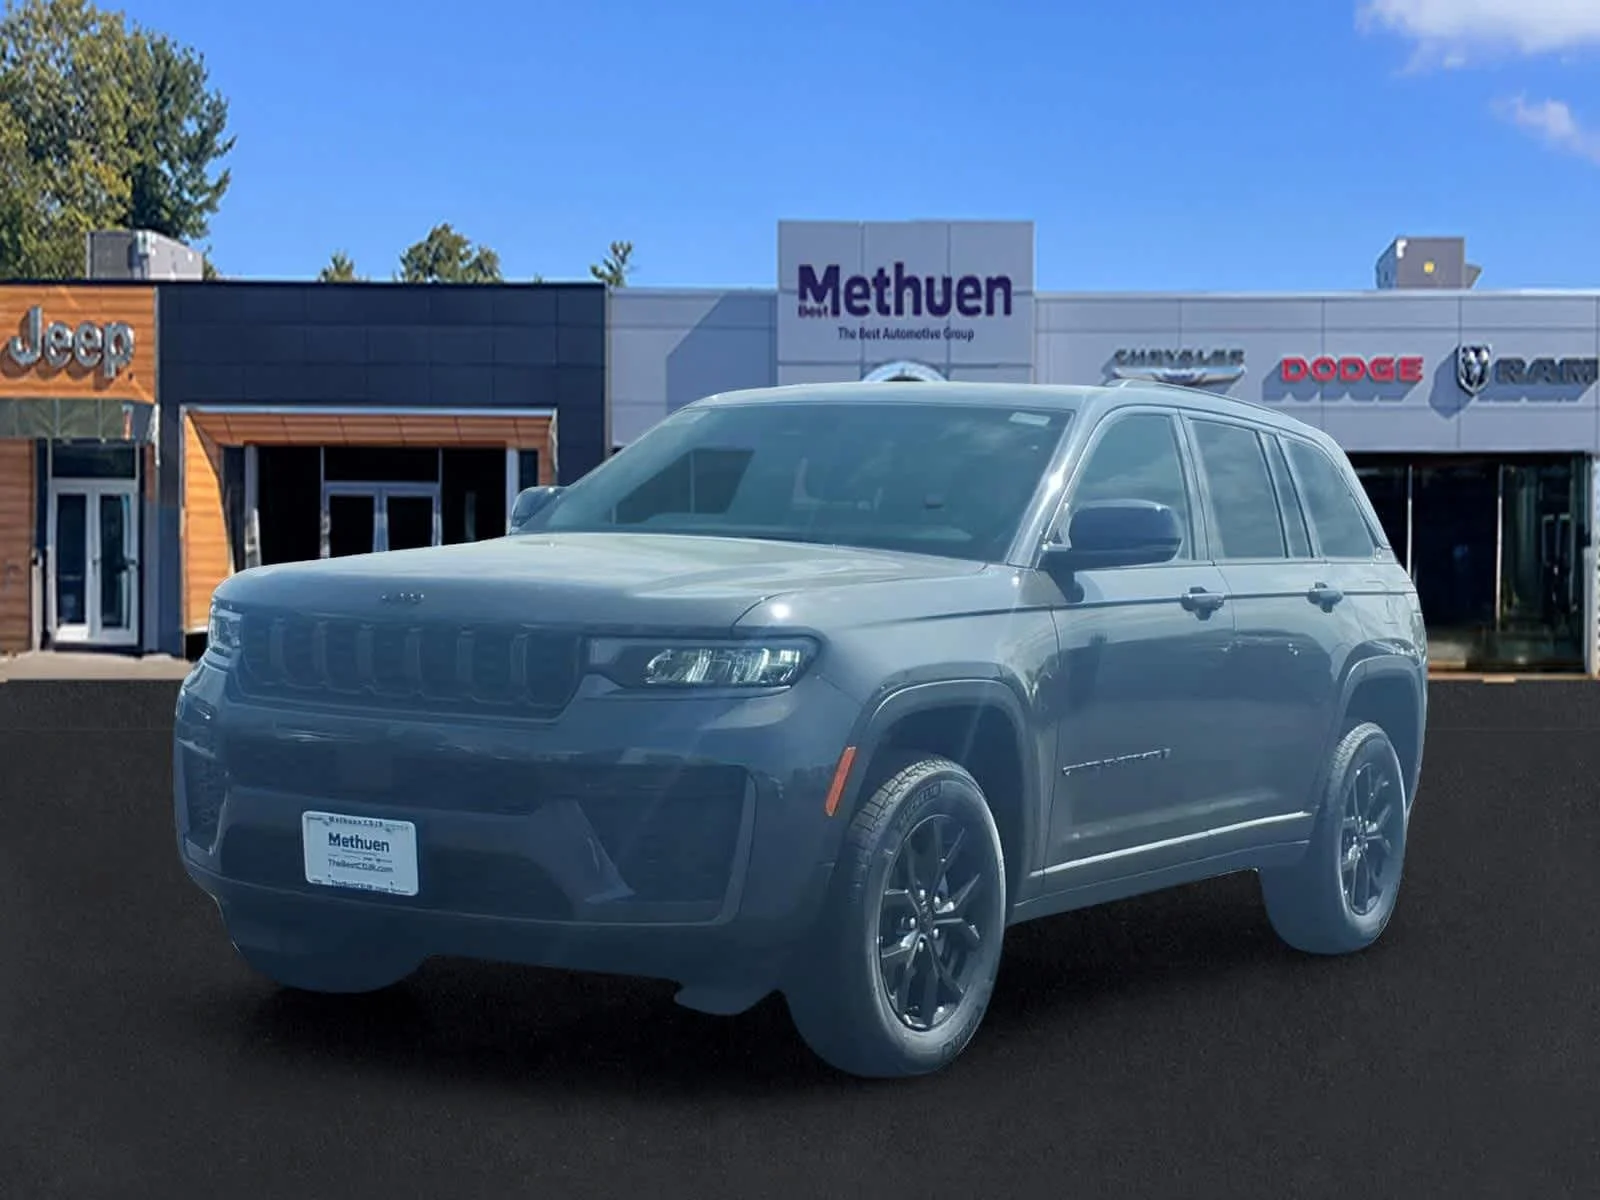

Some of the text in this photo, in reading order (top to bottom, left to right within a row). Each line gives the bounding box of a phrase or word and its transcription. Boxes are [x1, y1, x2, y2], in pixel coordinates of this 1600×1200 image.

[798, 261, 1012, 317] Methuen
[9, 305, 135, 378] Jeep
[838, 327, 974, 342] The Best Automotive Group
[1114, 349, 1244, 366] CHRYSLER
[1281, 356, 1423, 382] DODGE
[1497, 357, 1598, 384] RAM
[328, 832, 390, 852] Methuen
